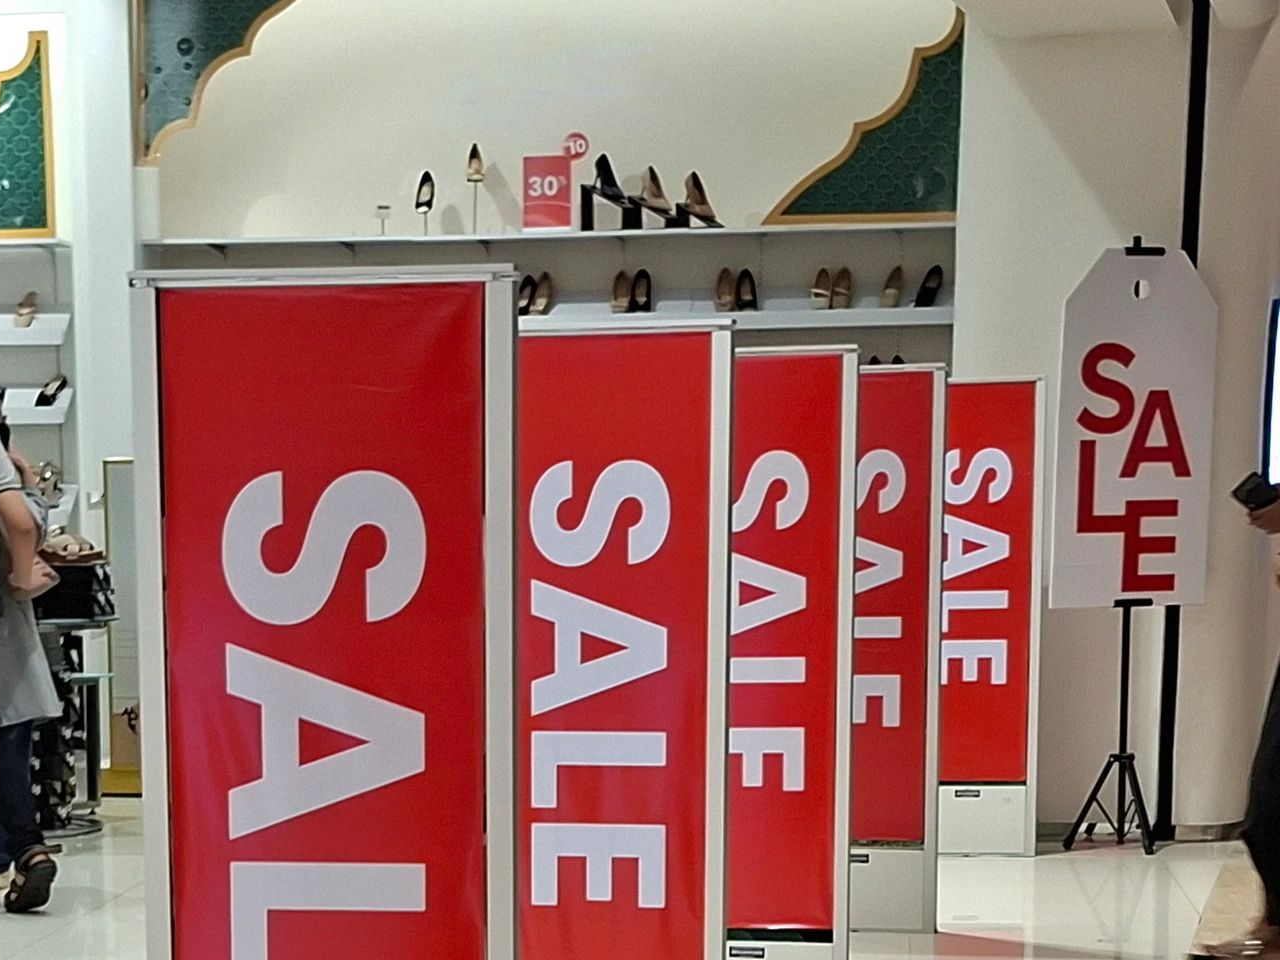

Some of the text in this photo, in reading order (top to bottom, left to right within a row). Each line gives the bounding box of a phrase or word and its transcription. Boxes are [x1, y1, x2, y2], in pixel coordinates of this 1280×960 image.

[940, 447, 1013, 686] SALE
[1076, 341, 1192, 592] SALE
[528, 459, 671, 909] SALE
